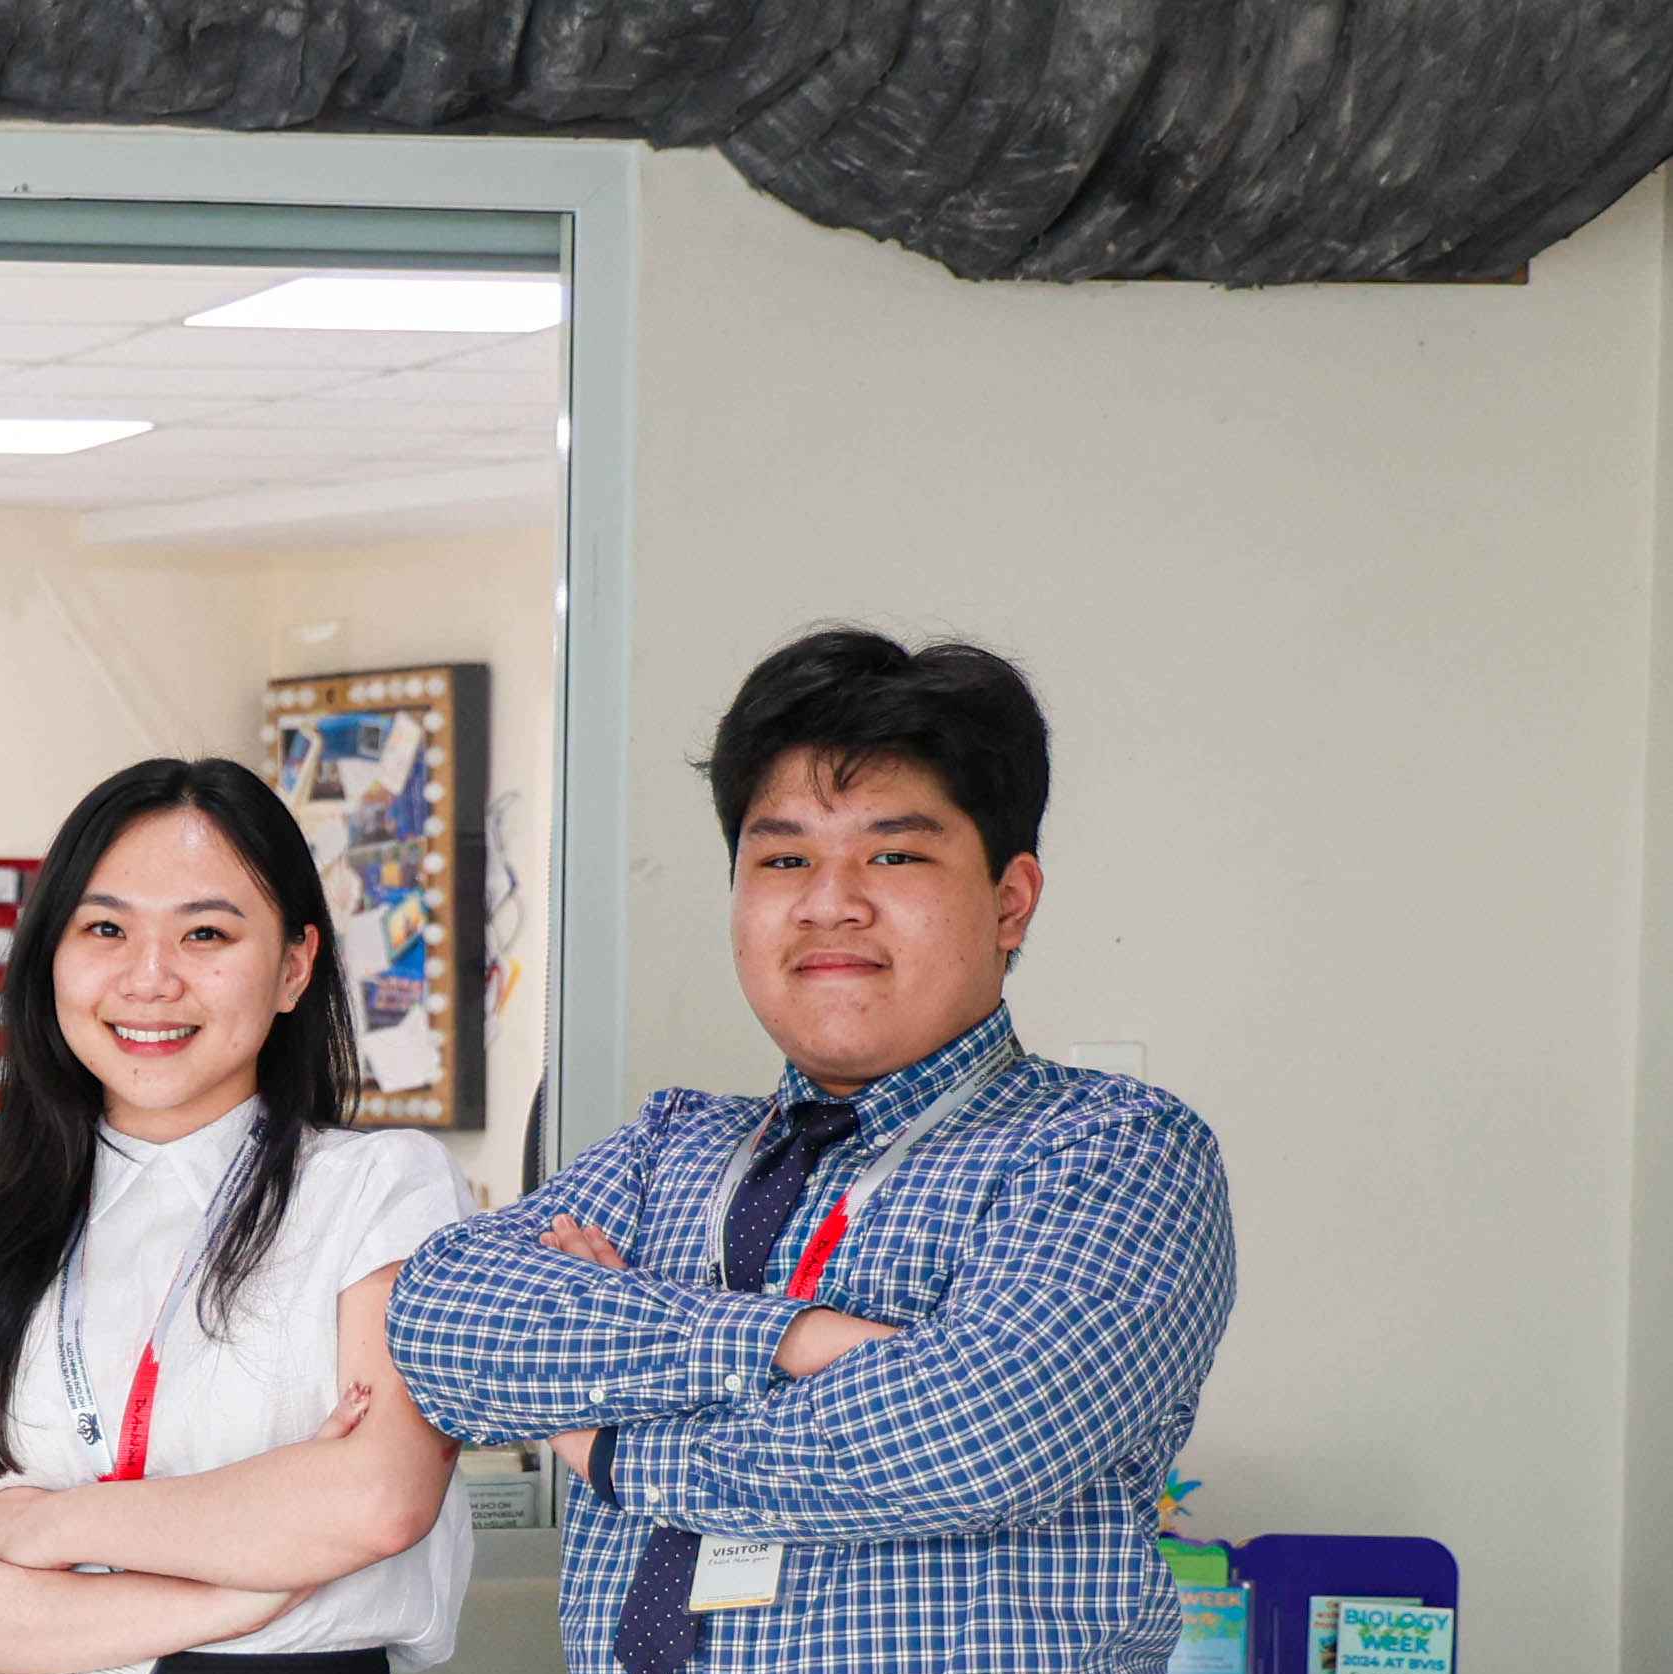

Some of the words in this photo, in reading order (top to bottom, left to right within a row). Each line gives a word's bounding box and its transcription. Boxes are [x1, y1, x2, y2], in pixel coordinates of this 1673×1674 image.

[713, 1543, 768, 1557] VISITOR
[1344, 1607, 1448, 1633] BIOLOGY
[1360, 1634, 1430, 1654] WEEK
[1342, 1655, 1380, 1668] 2024
[1384, 1656, 1405, 1669] AT
[1408, 1658, 1446, 1671] BVIS
